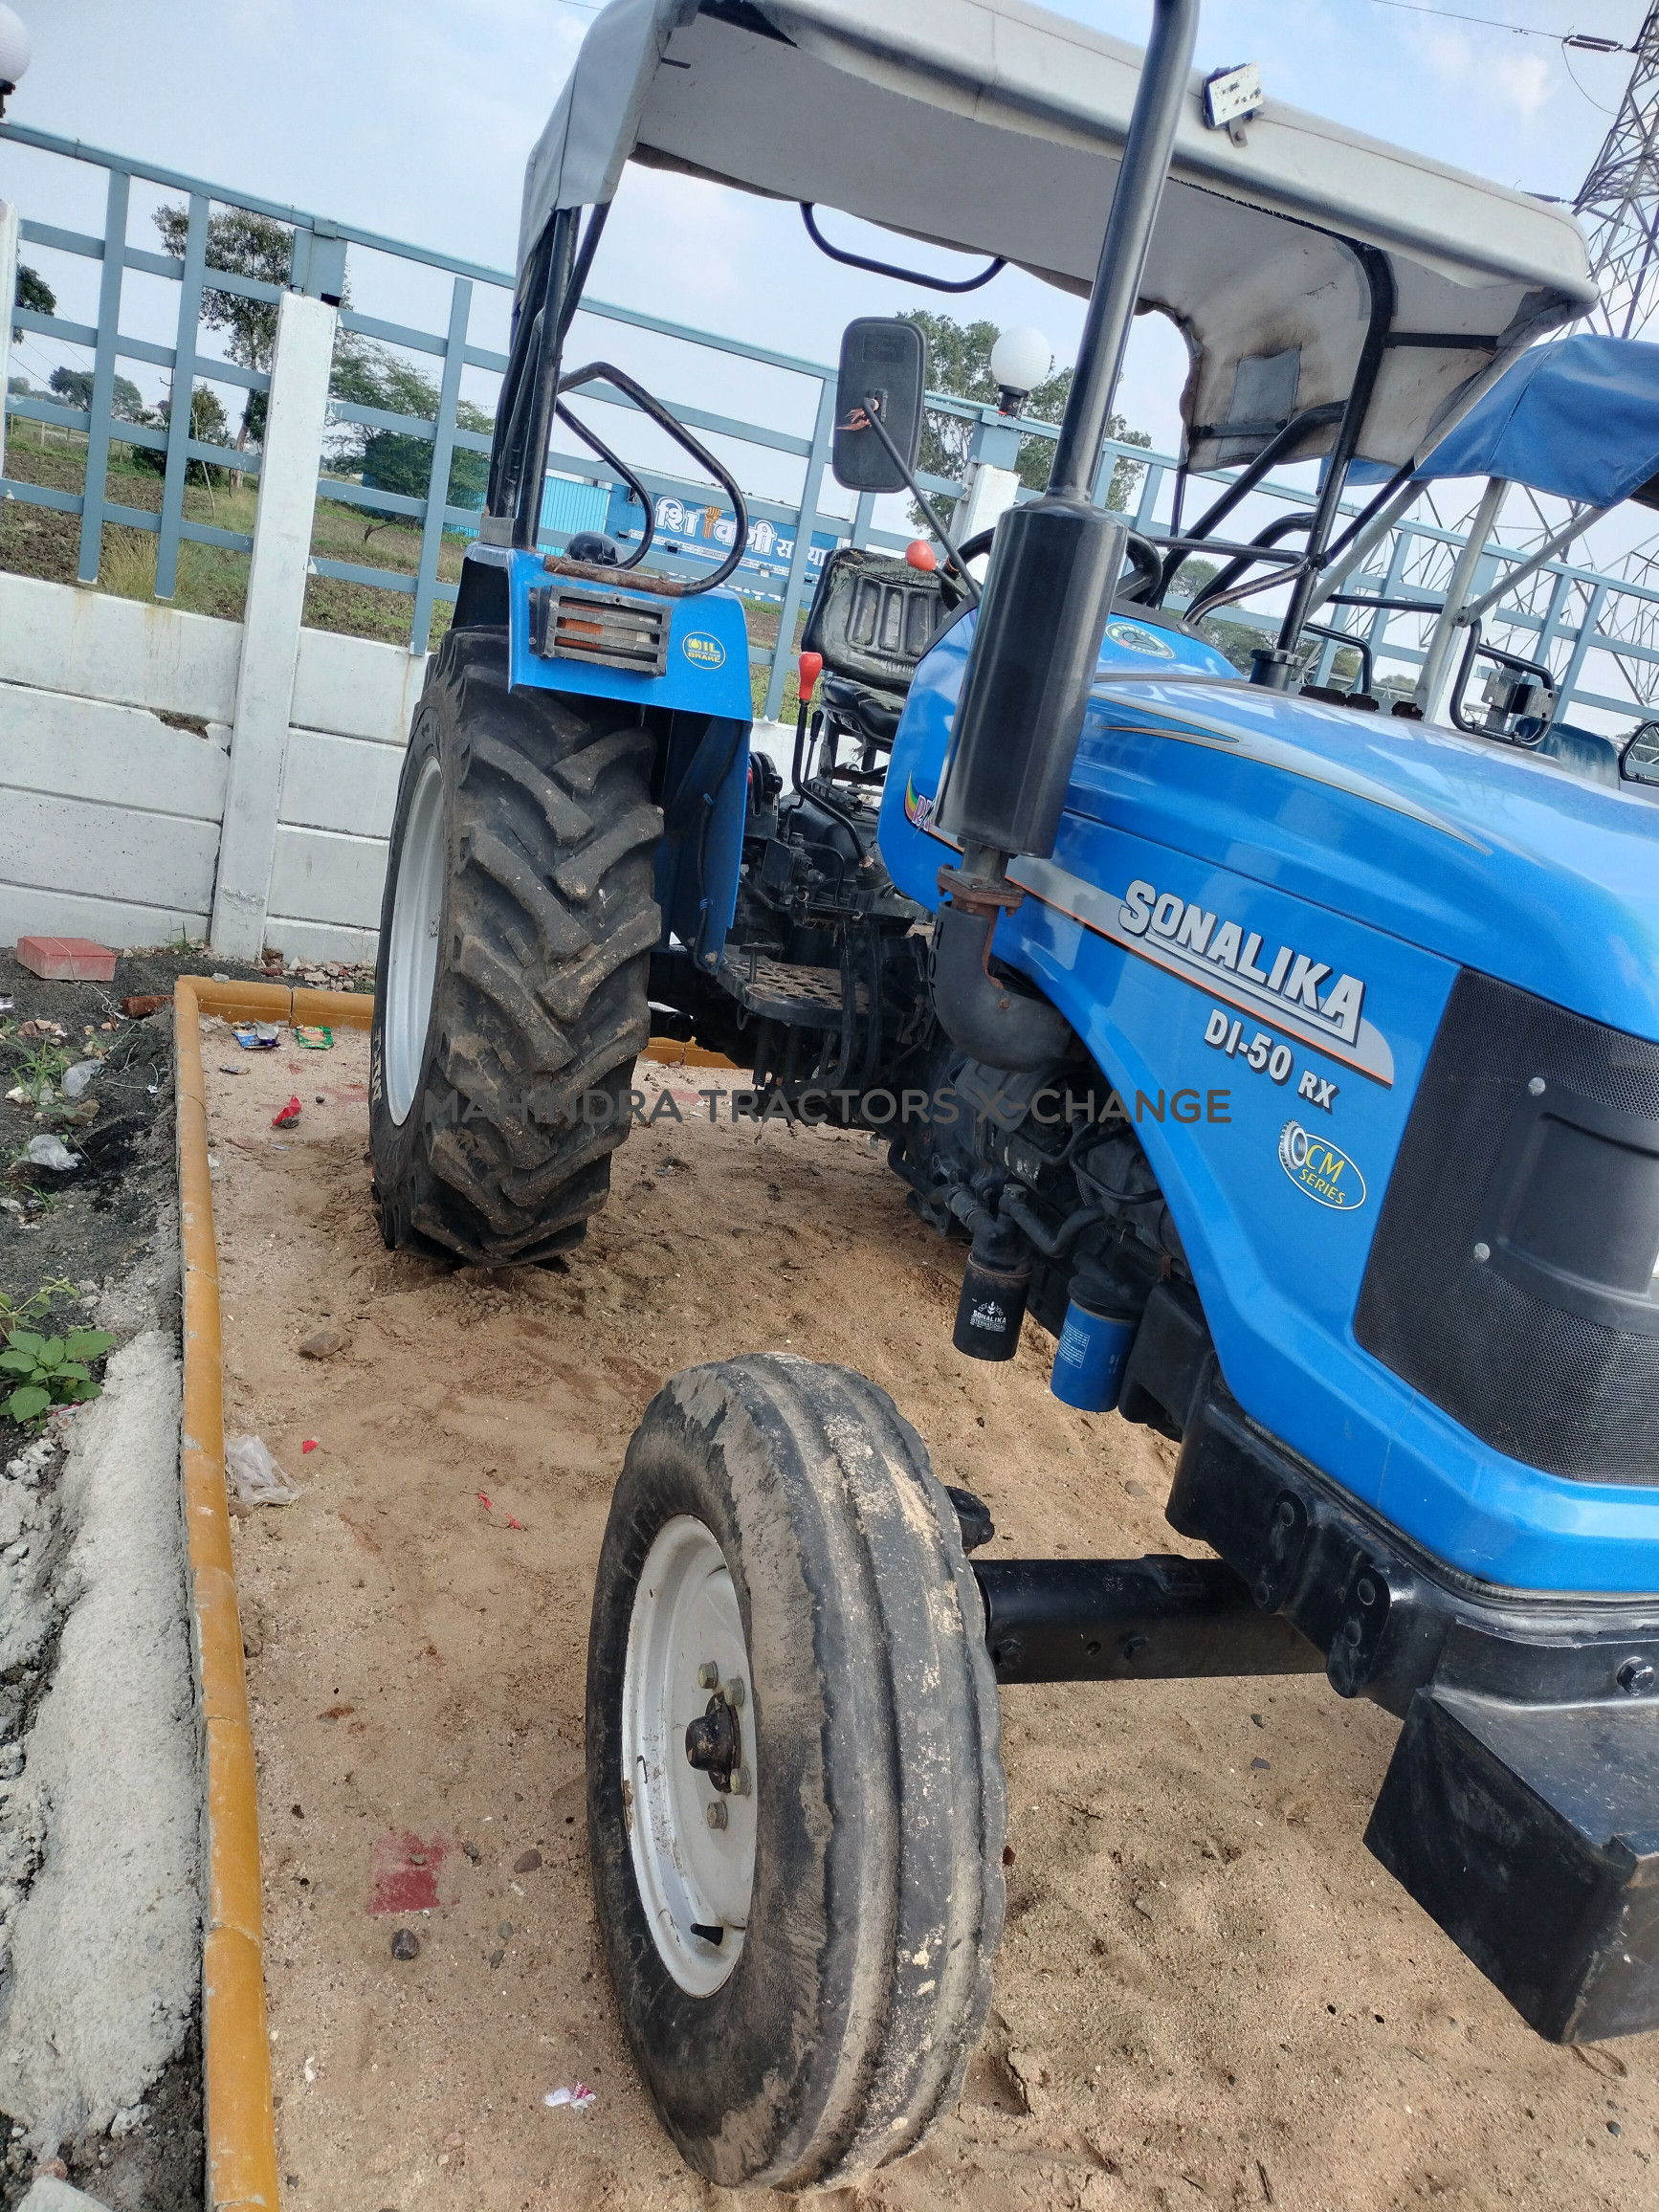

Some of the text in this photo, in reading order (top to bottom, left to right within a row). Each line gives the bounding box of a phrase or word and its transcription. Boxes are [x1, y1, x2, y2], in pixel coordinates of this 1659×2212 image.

[688, 652, 720, 663] BRAKE
[1118, 879, 1366, 1046] SONALIKA
[1204, 1008, 1339, 1114] DI-50 RX
[1298, 1168, 1346, 1205] SERIES
